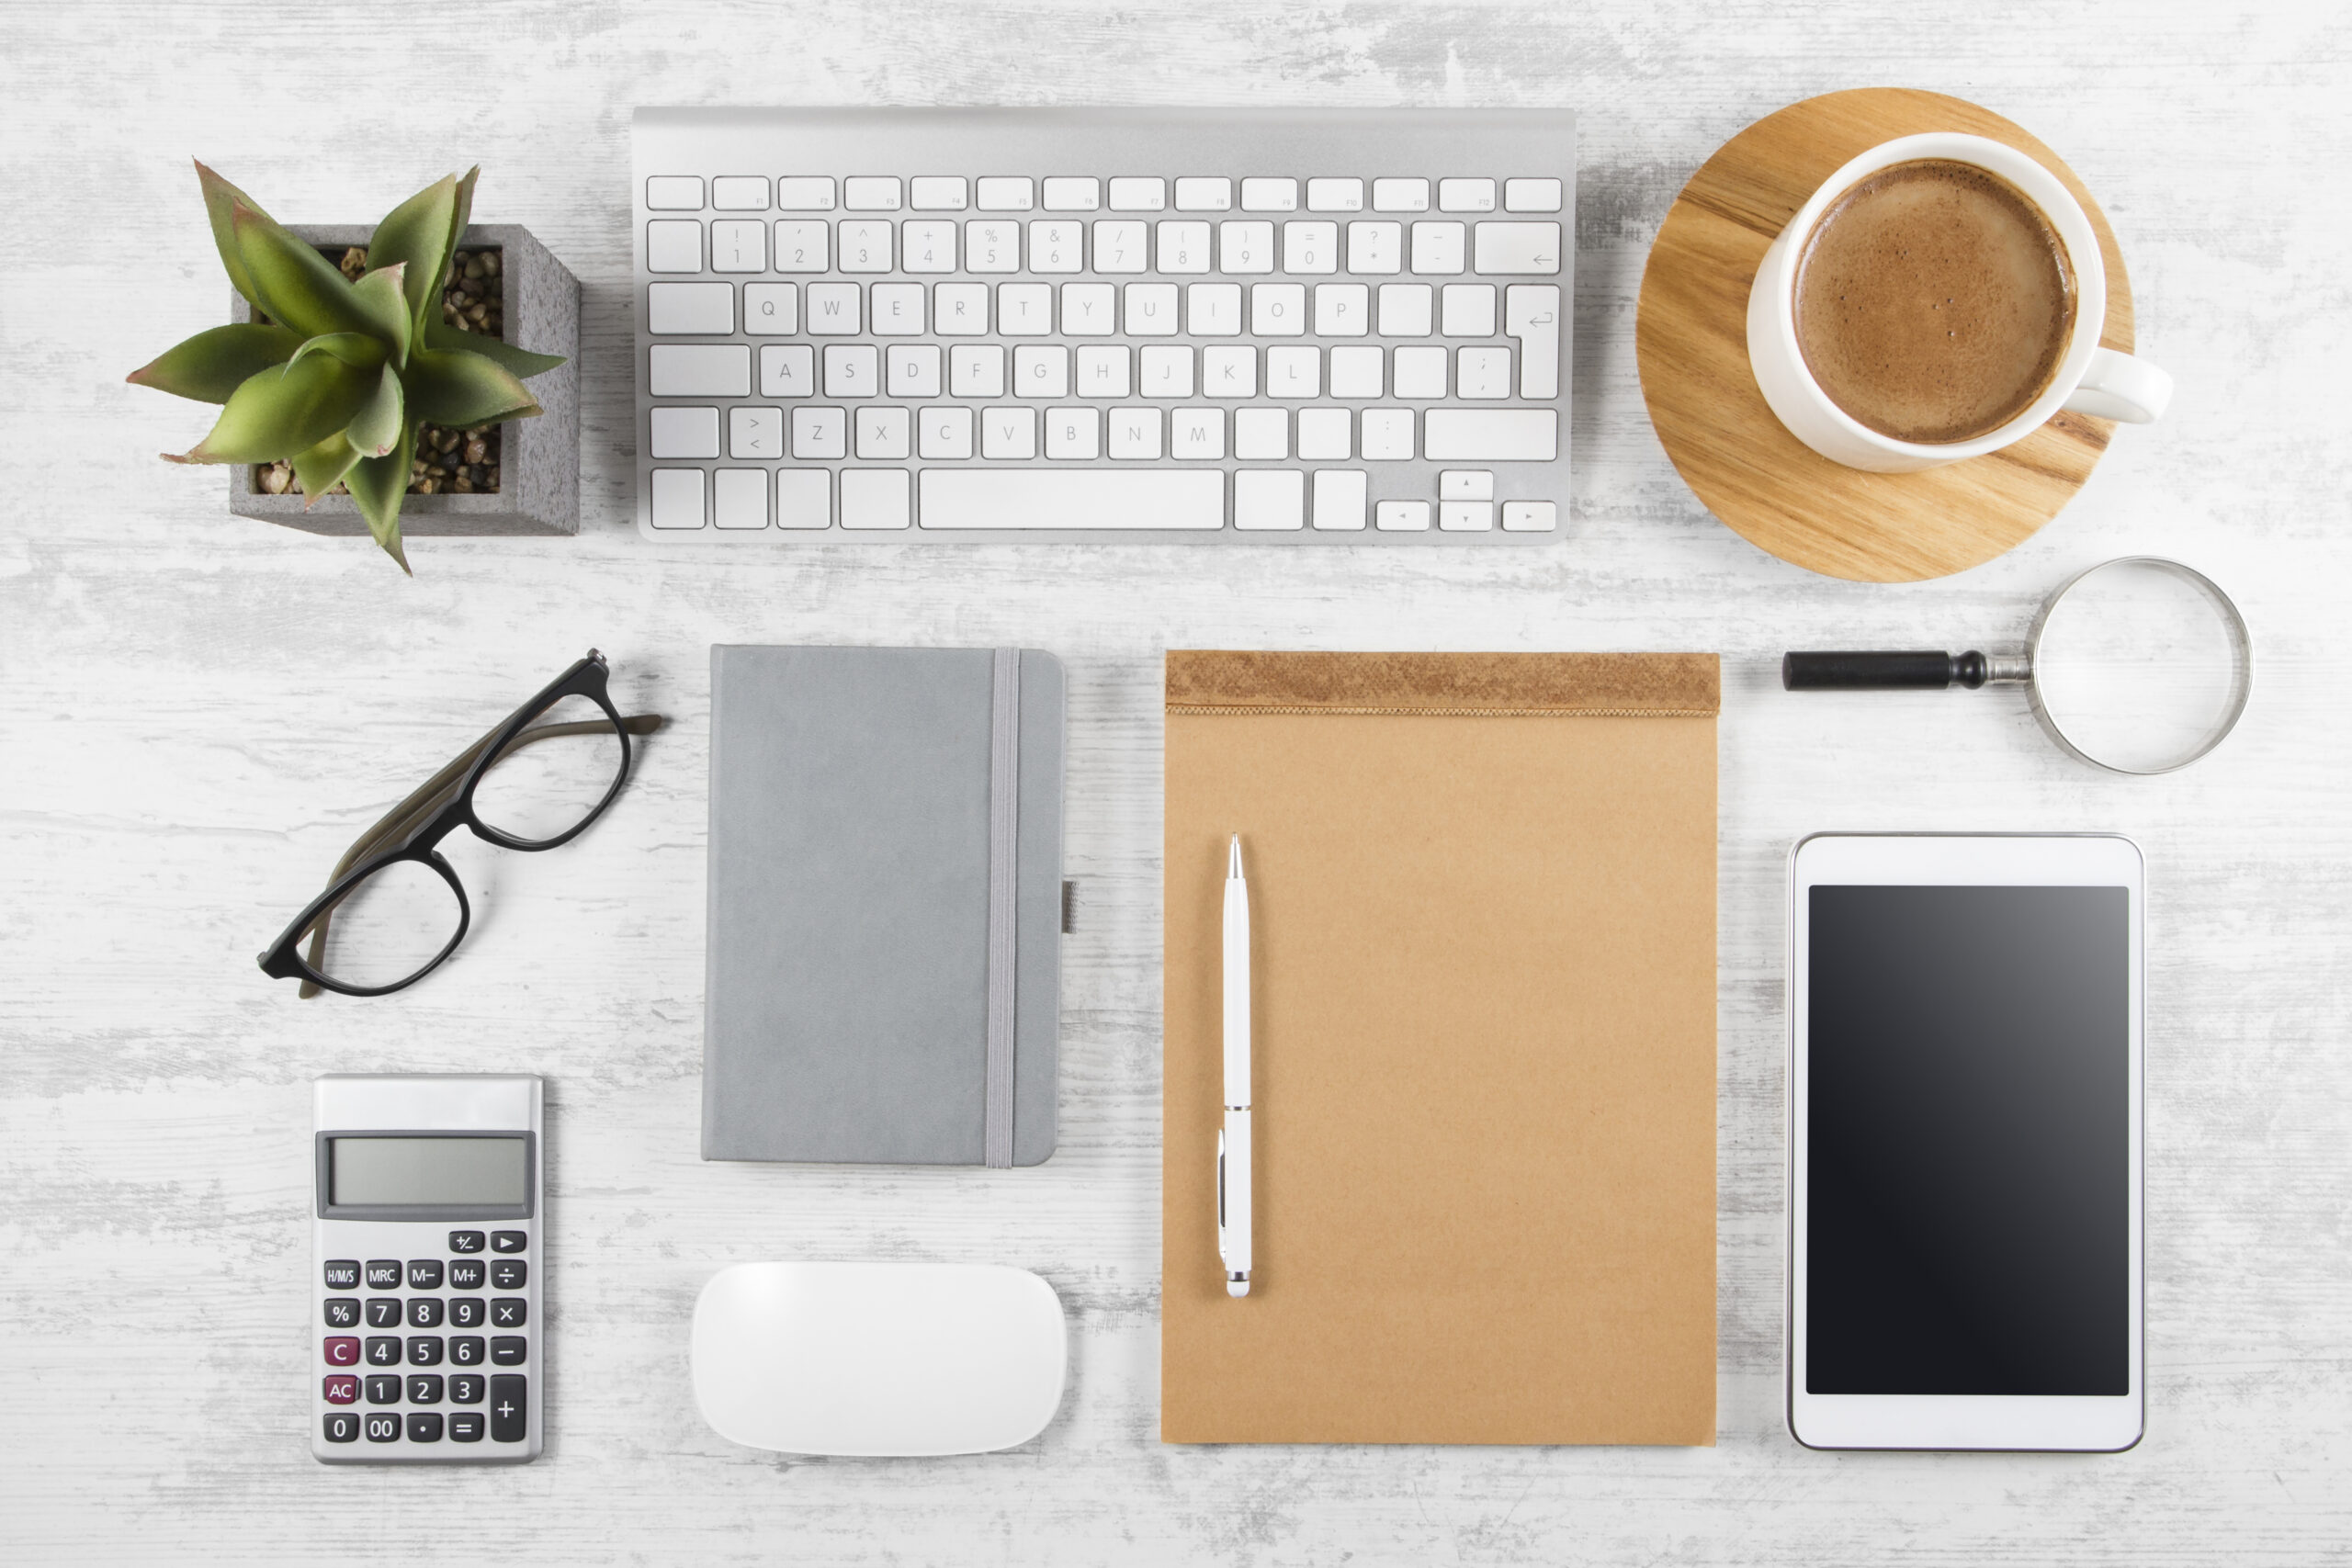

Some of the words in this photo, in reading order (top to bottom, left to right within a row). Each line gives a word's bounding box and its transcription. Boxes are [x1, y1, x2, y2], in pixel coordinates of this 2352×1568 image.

[820, 197, 829, 206] F2
[886, 197, 895, 206] F3
[1018, 197, 1027, 206] F5
[1084, 197, 1093, 206] F6
[1150, 197, 1159, 206] F7
[1283, 198, 1291, 207] F9
[1346, 198, 1358, 207] F10
[1478, 198, 1490, 207] F12
[923, 231, 933, 241] +
[984, 229, 999, 243] %
[1049, 229, 1060, 243] &
[1370, 230, 1379, 244] ?
[795, 248, 804, 264] 2
[859, 248, 868, 264] 3
[923, 249, 933, 264] 4
[987, 249, 996, 264] 5
[1050, 249, 1059, 264] 6
[1114, 249, 1125, 265] 7
[1178, 250, 1188, 265] 8
[1241, 250, 1250, 265] 9
[1304, 250, 1315, 265] 0
[761, 300, 775, 316] Q
[823, 300, 840, 316] W
[892, 300, 900, 316] E
[956, 300, 965, 316] R
[1019, 300, 1028, 317] T
[1082, 301, 1092, 317] Y
[1144, 301, 1156, 317] U
[1271, 302, 1284, 318] O
[1337, 302, 1347, 318] P
[779, 363, 792, 378] A
[845, 363, 855, 378] S
[907, 362, 919, 378] D
[972, 363, 981, 378] F
[1034, 363, 1047, 379] G
[1096, 364, 1109, 378] H
[1162, 365, 1170, 380] J
[1224, 365, 1235, 379] K
[1289, 364, 1298, 379] L
[750, 418, 760, 428] >
[812, 424, 823, 441] Z
[876, 425, 888, 441] X
[938, 424, 952, 440] C
[1002, 425, 1015, 441] V
[1067, 425, 1077, 441] B
[1128, 426, 1141, 442] N
[1190, 426, 1206, 442] M
[750, 439, 760, 449] <
[327, 1269, 354, 1282] H/M/S
[368, 1269, 395, 1282] MRC
[454, 1269, 477, 1281] M+
[333, 1305, 350, 1322] %
[376, 1304, 388, 1323] 7
[417, 1304, 430, 1323] 8
[459, 1304, 471, 1323] 9
[333, 1343, 348, 1360] C
[375, 1343, 388, 1360] 4
[418, 1343, 429, 1361] 5
[458, 1342, 470, 1360] 6
[328, 1383, 353, 1398] AC
[376, 1382, 384, 1399] 1
[417, 1382, 429, 1400] 2
[458, 1381, 470, 1399] 3
[497, 1400, 514, 1418] +
[334, 1419, 346, 1438] 0
[369, 1420, 393, 1438] 00
